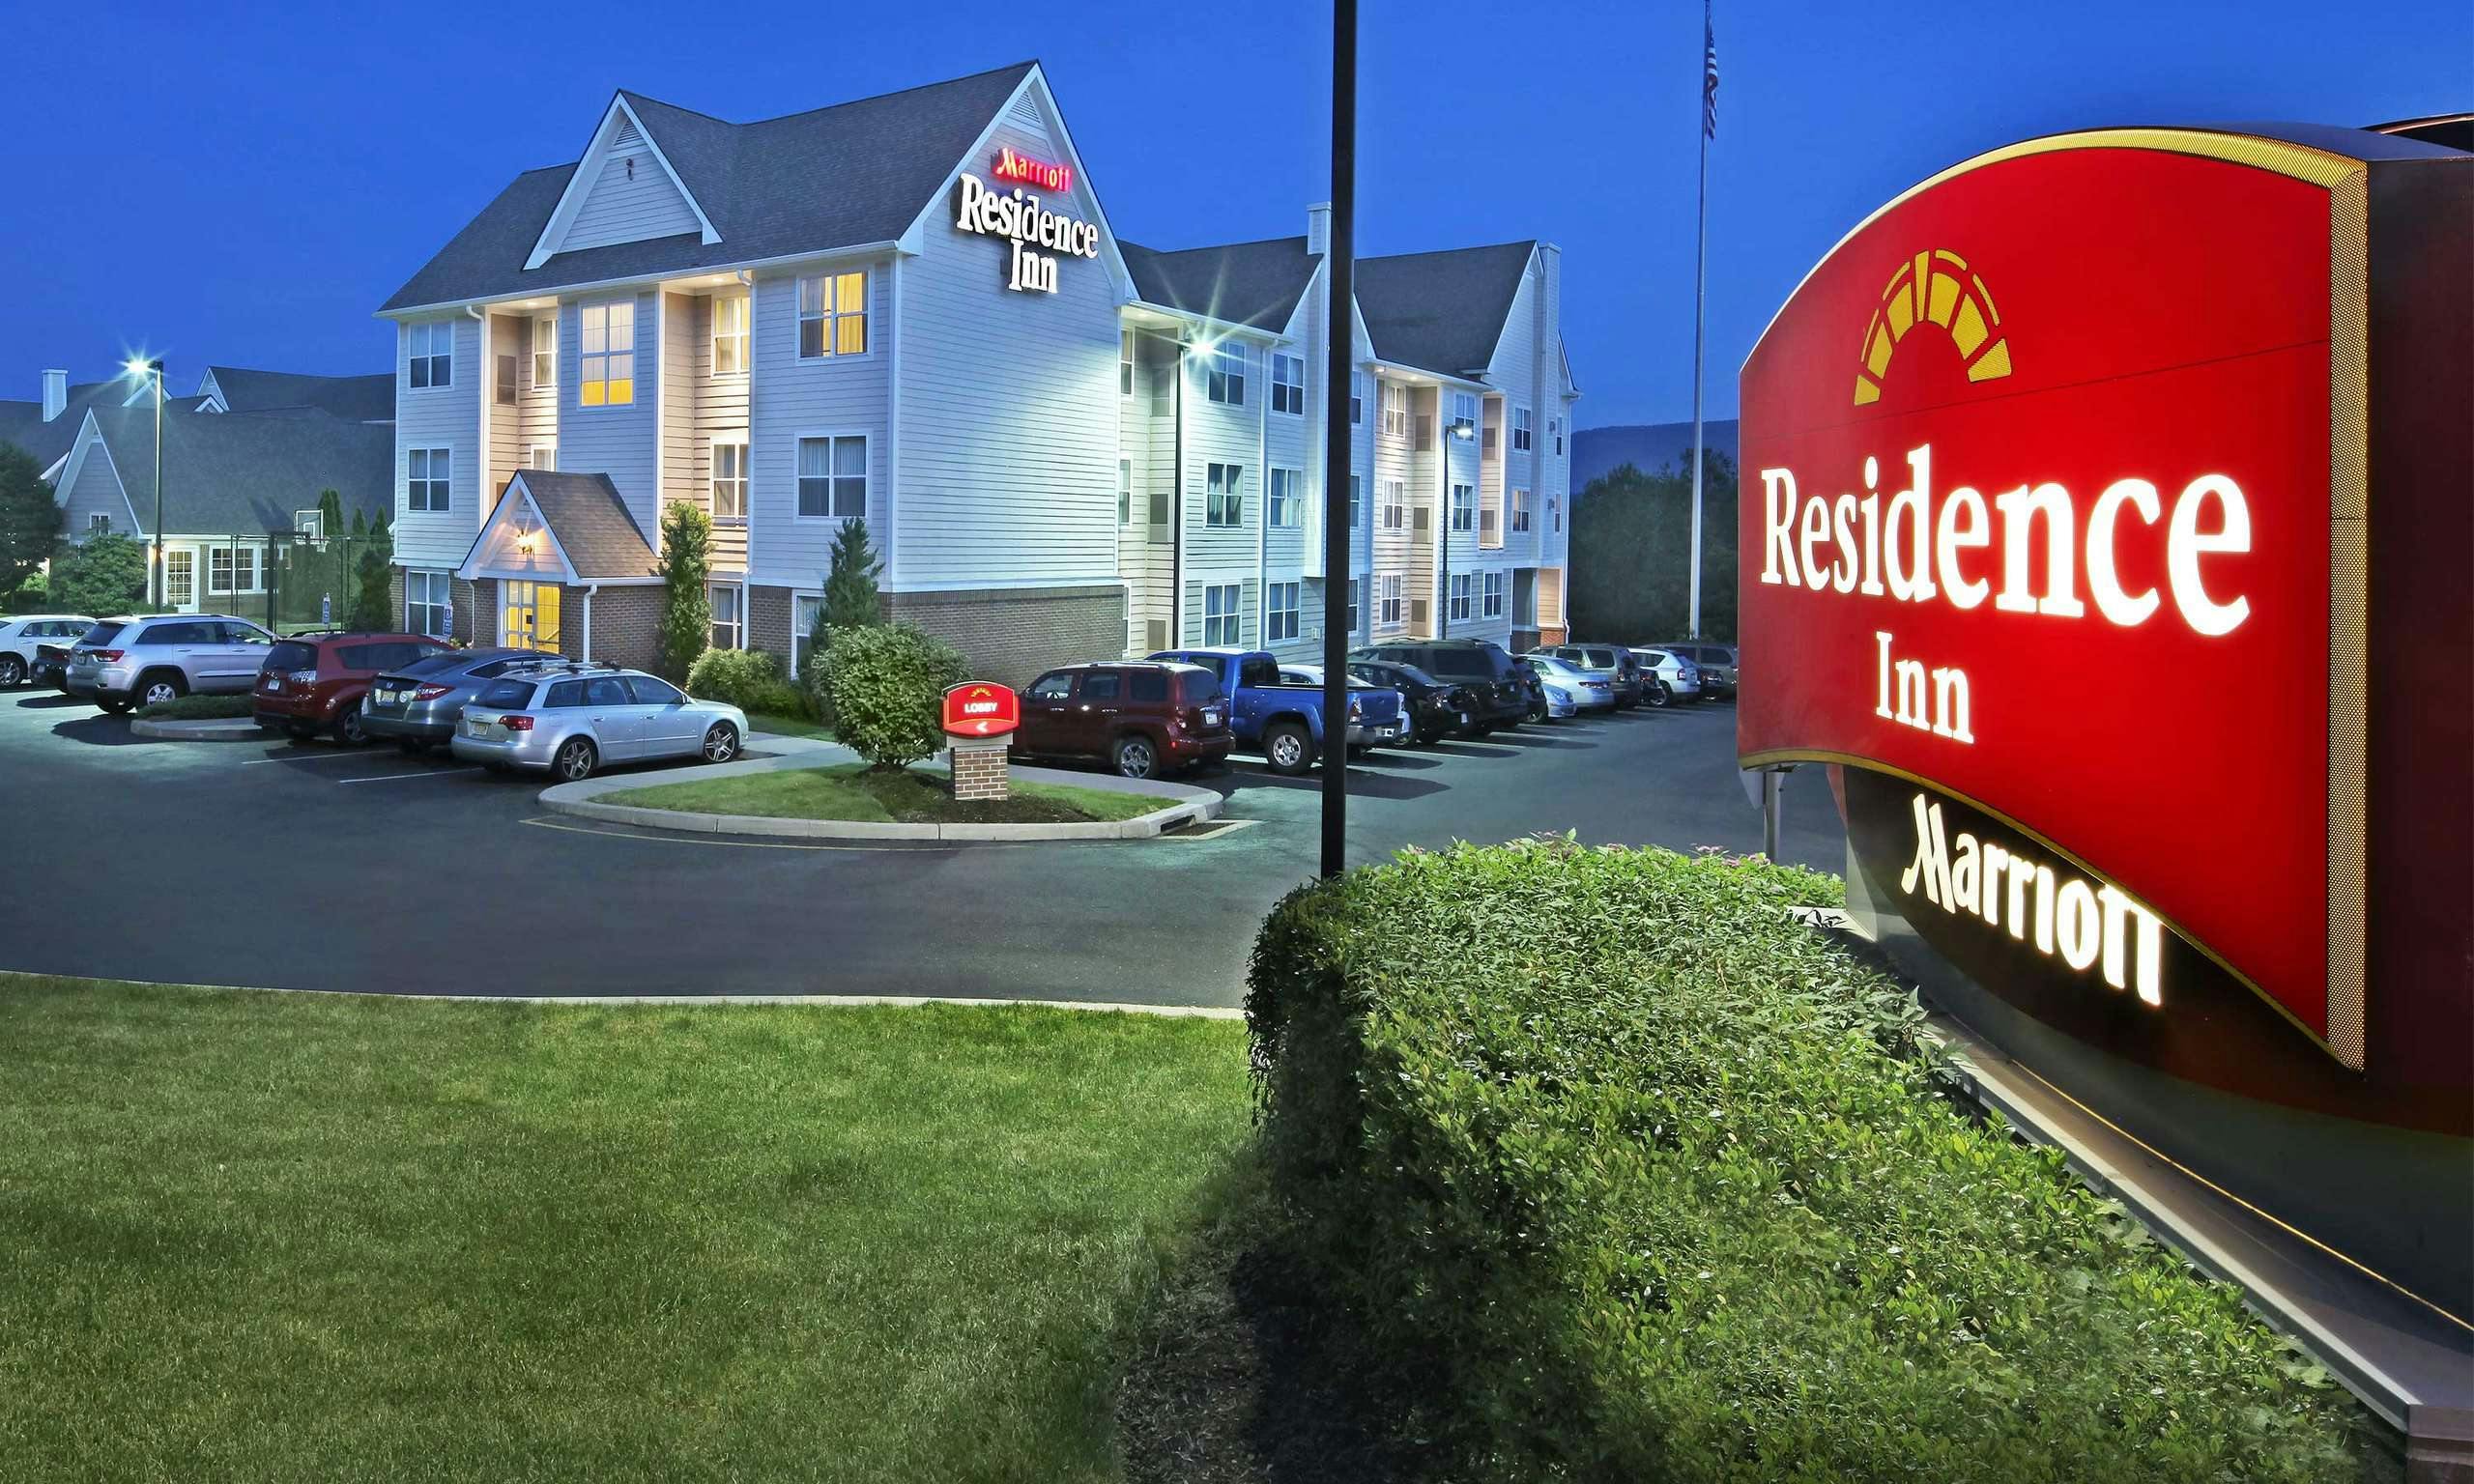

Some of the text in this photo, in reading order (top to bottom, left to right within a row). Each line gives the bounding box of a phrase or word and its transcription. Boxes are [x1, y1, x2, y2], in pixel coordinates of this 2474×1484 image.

[996, 147, 1071, 192] Marriott
[956, 173, 1099, 259] Residence
[1008, 239, 1058, 294] Inn
[1760, 442, 2252, 638] Residence
[964, 701, 997, 714] LOBBY
[1875, 630, 1974, 744] Inn
[1901, 792, 2164, 1007] Marriott
